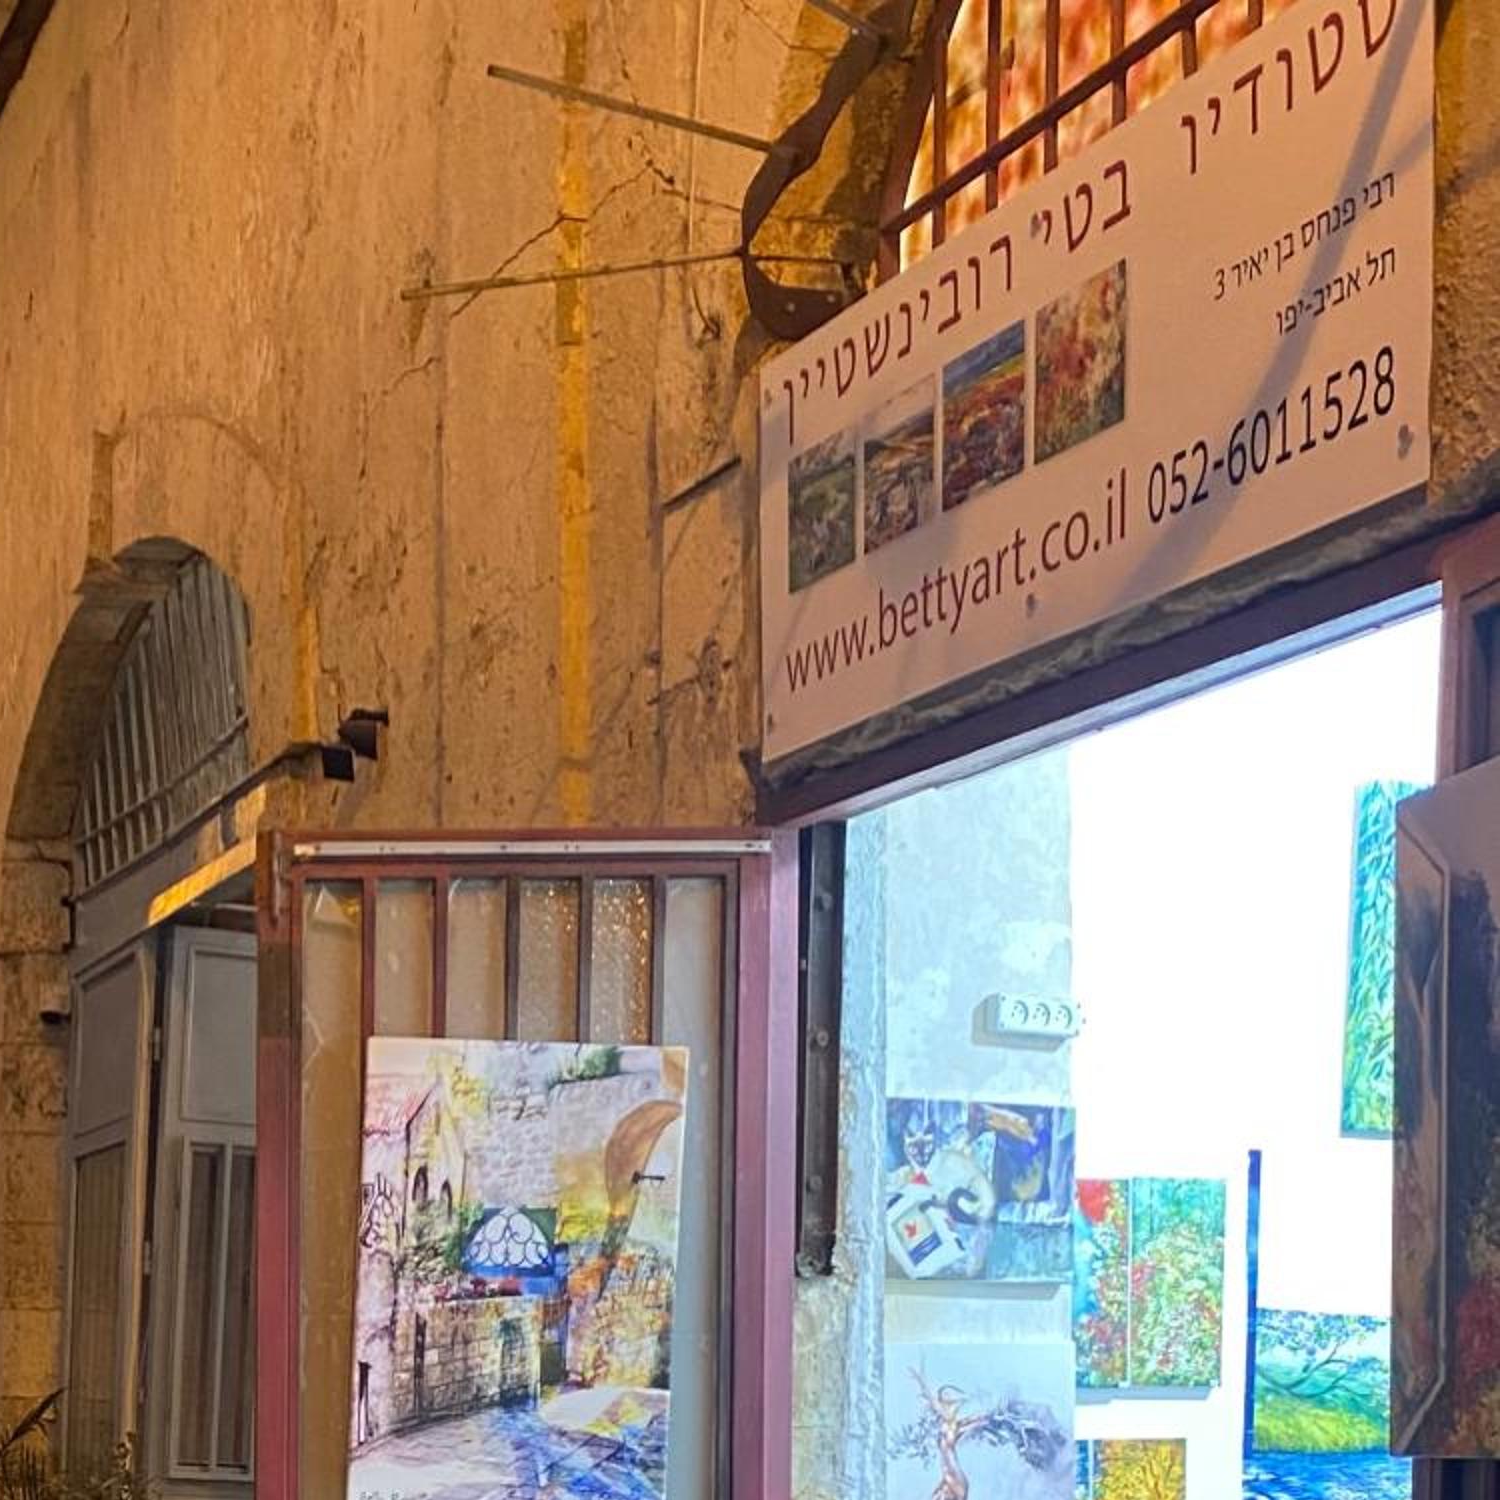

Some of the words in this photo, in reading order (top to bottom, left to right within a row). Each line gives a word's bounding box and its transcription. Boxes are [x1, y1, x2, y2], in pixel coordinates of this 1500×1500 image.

[1040, 160, 1132, 252] בטי
[1363, 172, 1395, 209] רבי
[1301, 197, 1357, 249] פנחס
[1231, 247, 1269, 288] יאיר
[1273, 232, 1295, 273] בן
[1366, 247, 1396, 287] תל
[1214, 268, 1226, 301] 3
[1275, 266, 1361, 336] אביב-יפו
[784, 234, 1012, 445] רובינשטיין
[785, 466, 1127, 693] www.bettyart.co.il
[1147, 345, 1396, 525] 052-6011528
